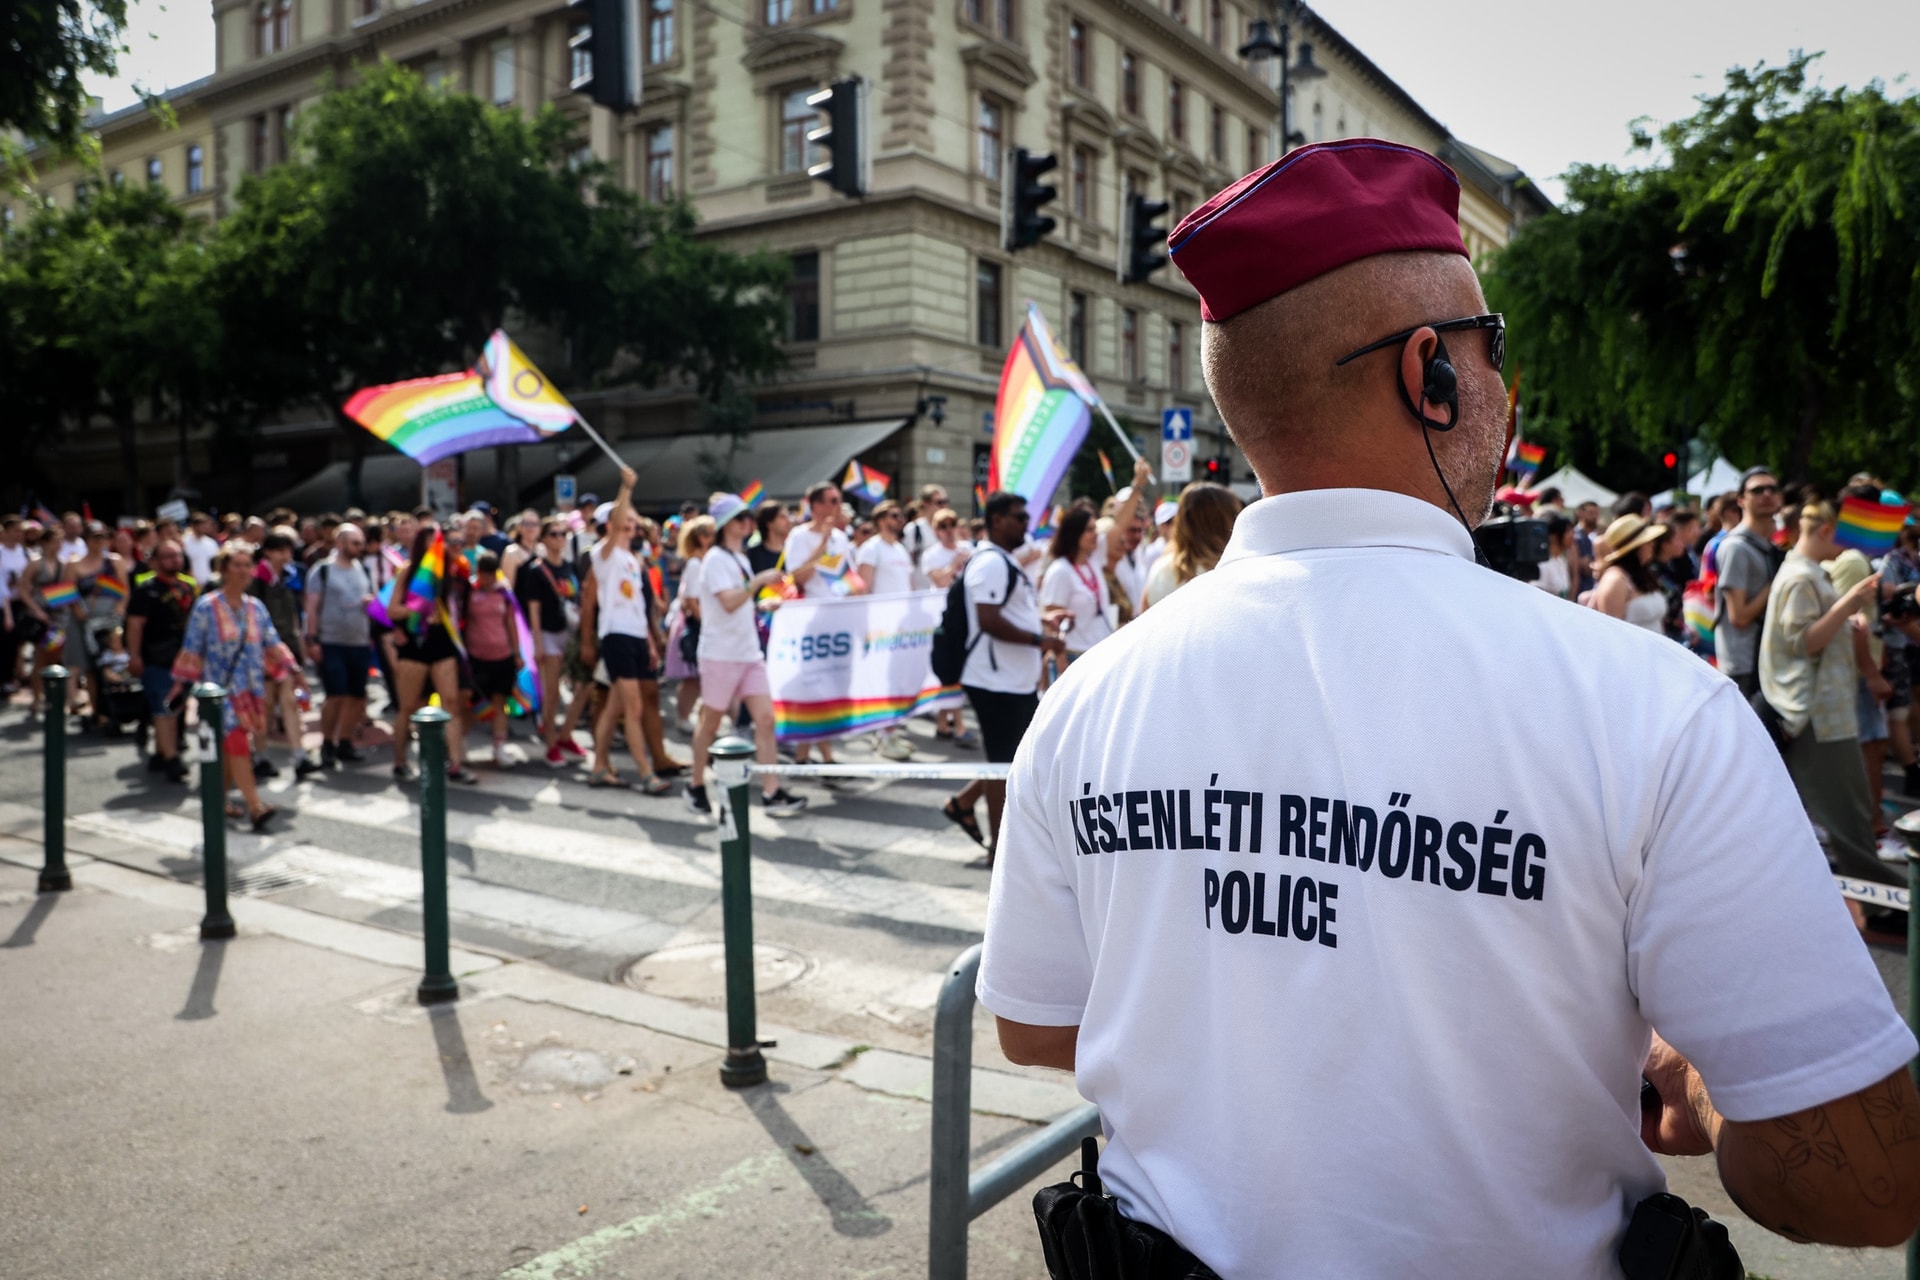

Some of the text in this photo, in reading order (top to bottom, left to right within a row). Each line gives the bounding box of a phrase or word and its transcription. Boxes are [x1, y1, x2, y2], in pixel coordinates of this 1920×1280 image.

[801, 632, 851, 661] BSS
[1069, 773, 1547, 902] KÉSZENLÉTI RENDŐRSÉG
[1204, 867, 1339, 949] POLICE
